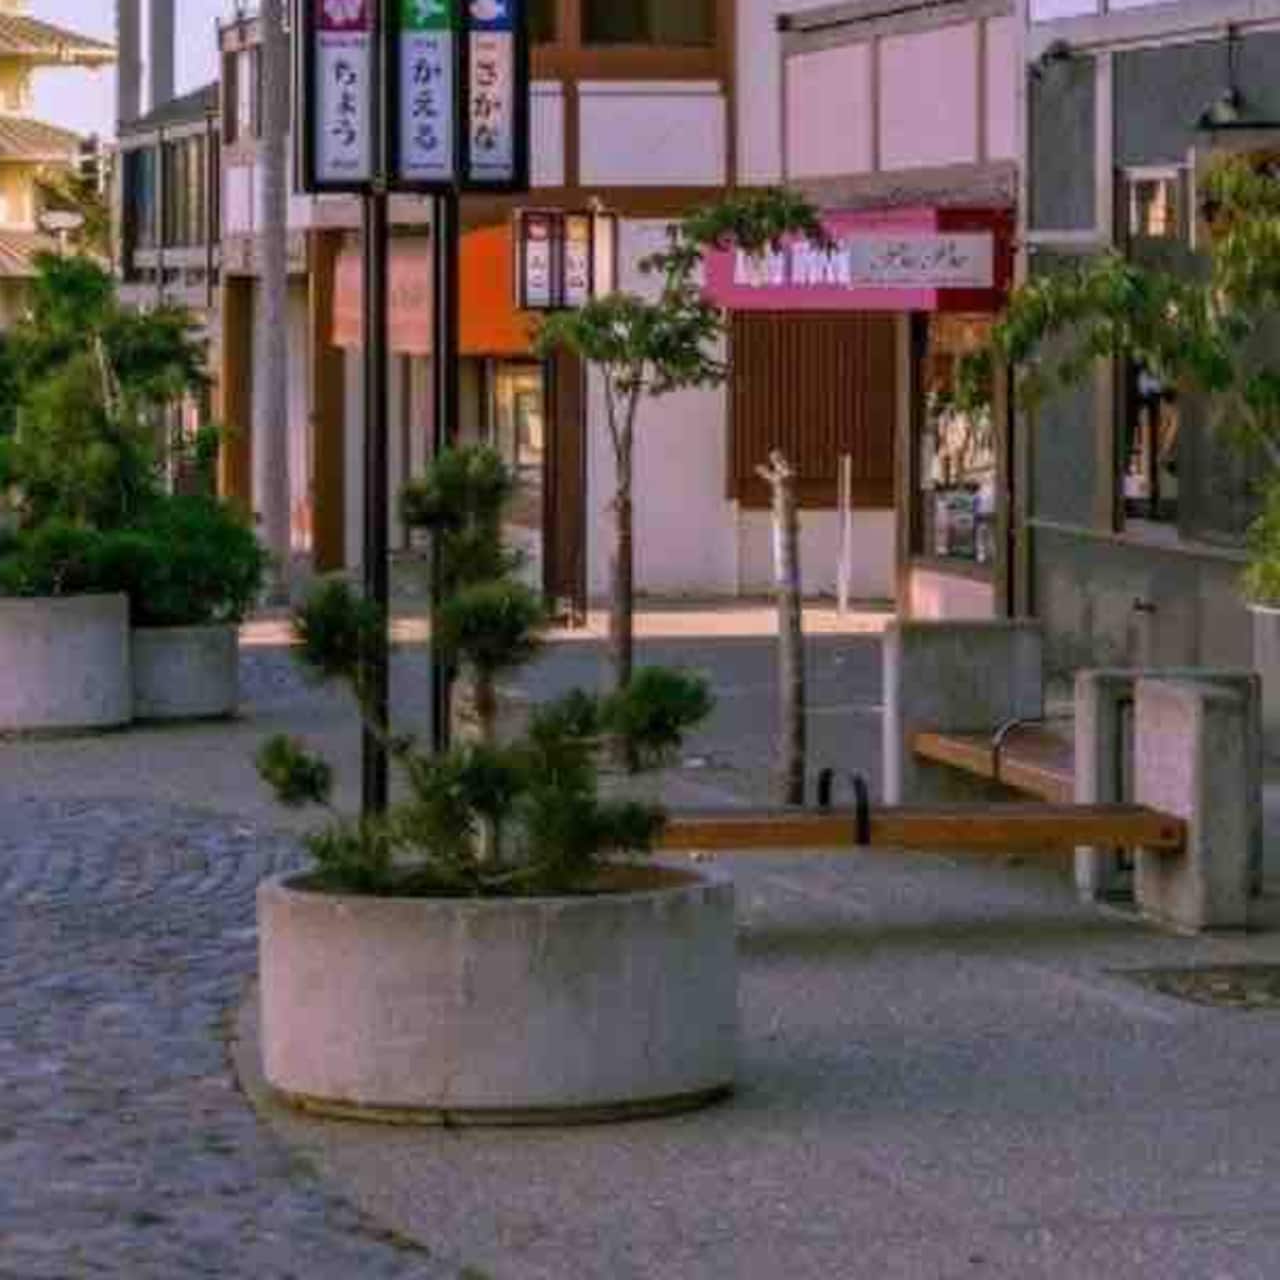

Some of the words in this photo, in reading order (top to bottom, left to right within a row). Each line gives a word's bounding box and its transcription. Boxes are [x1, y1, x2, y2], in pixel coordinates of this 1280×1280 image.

[332, 60, 357, 146] ちょう
[412, 57, 442, 151] かえる
[473, 60, 502, 150] さかな
